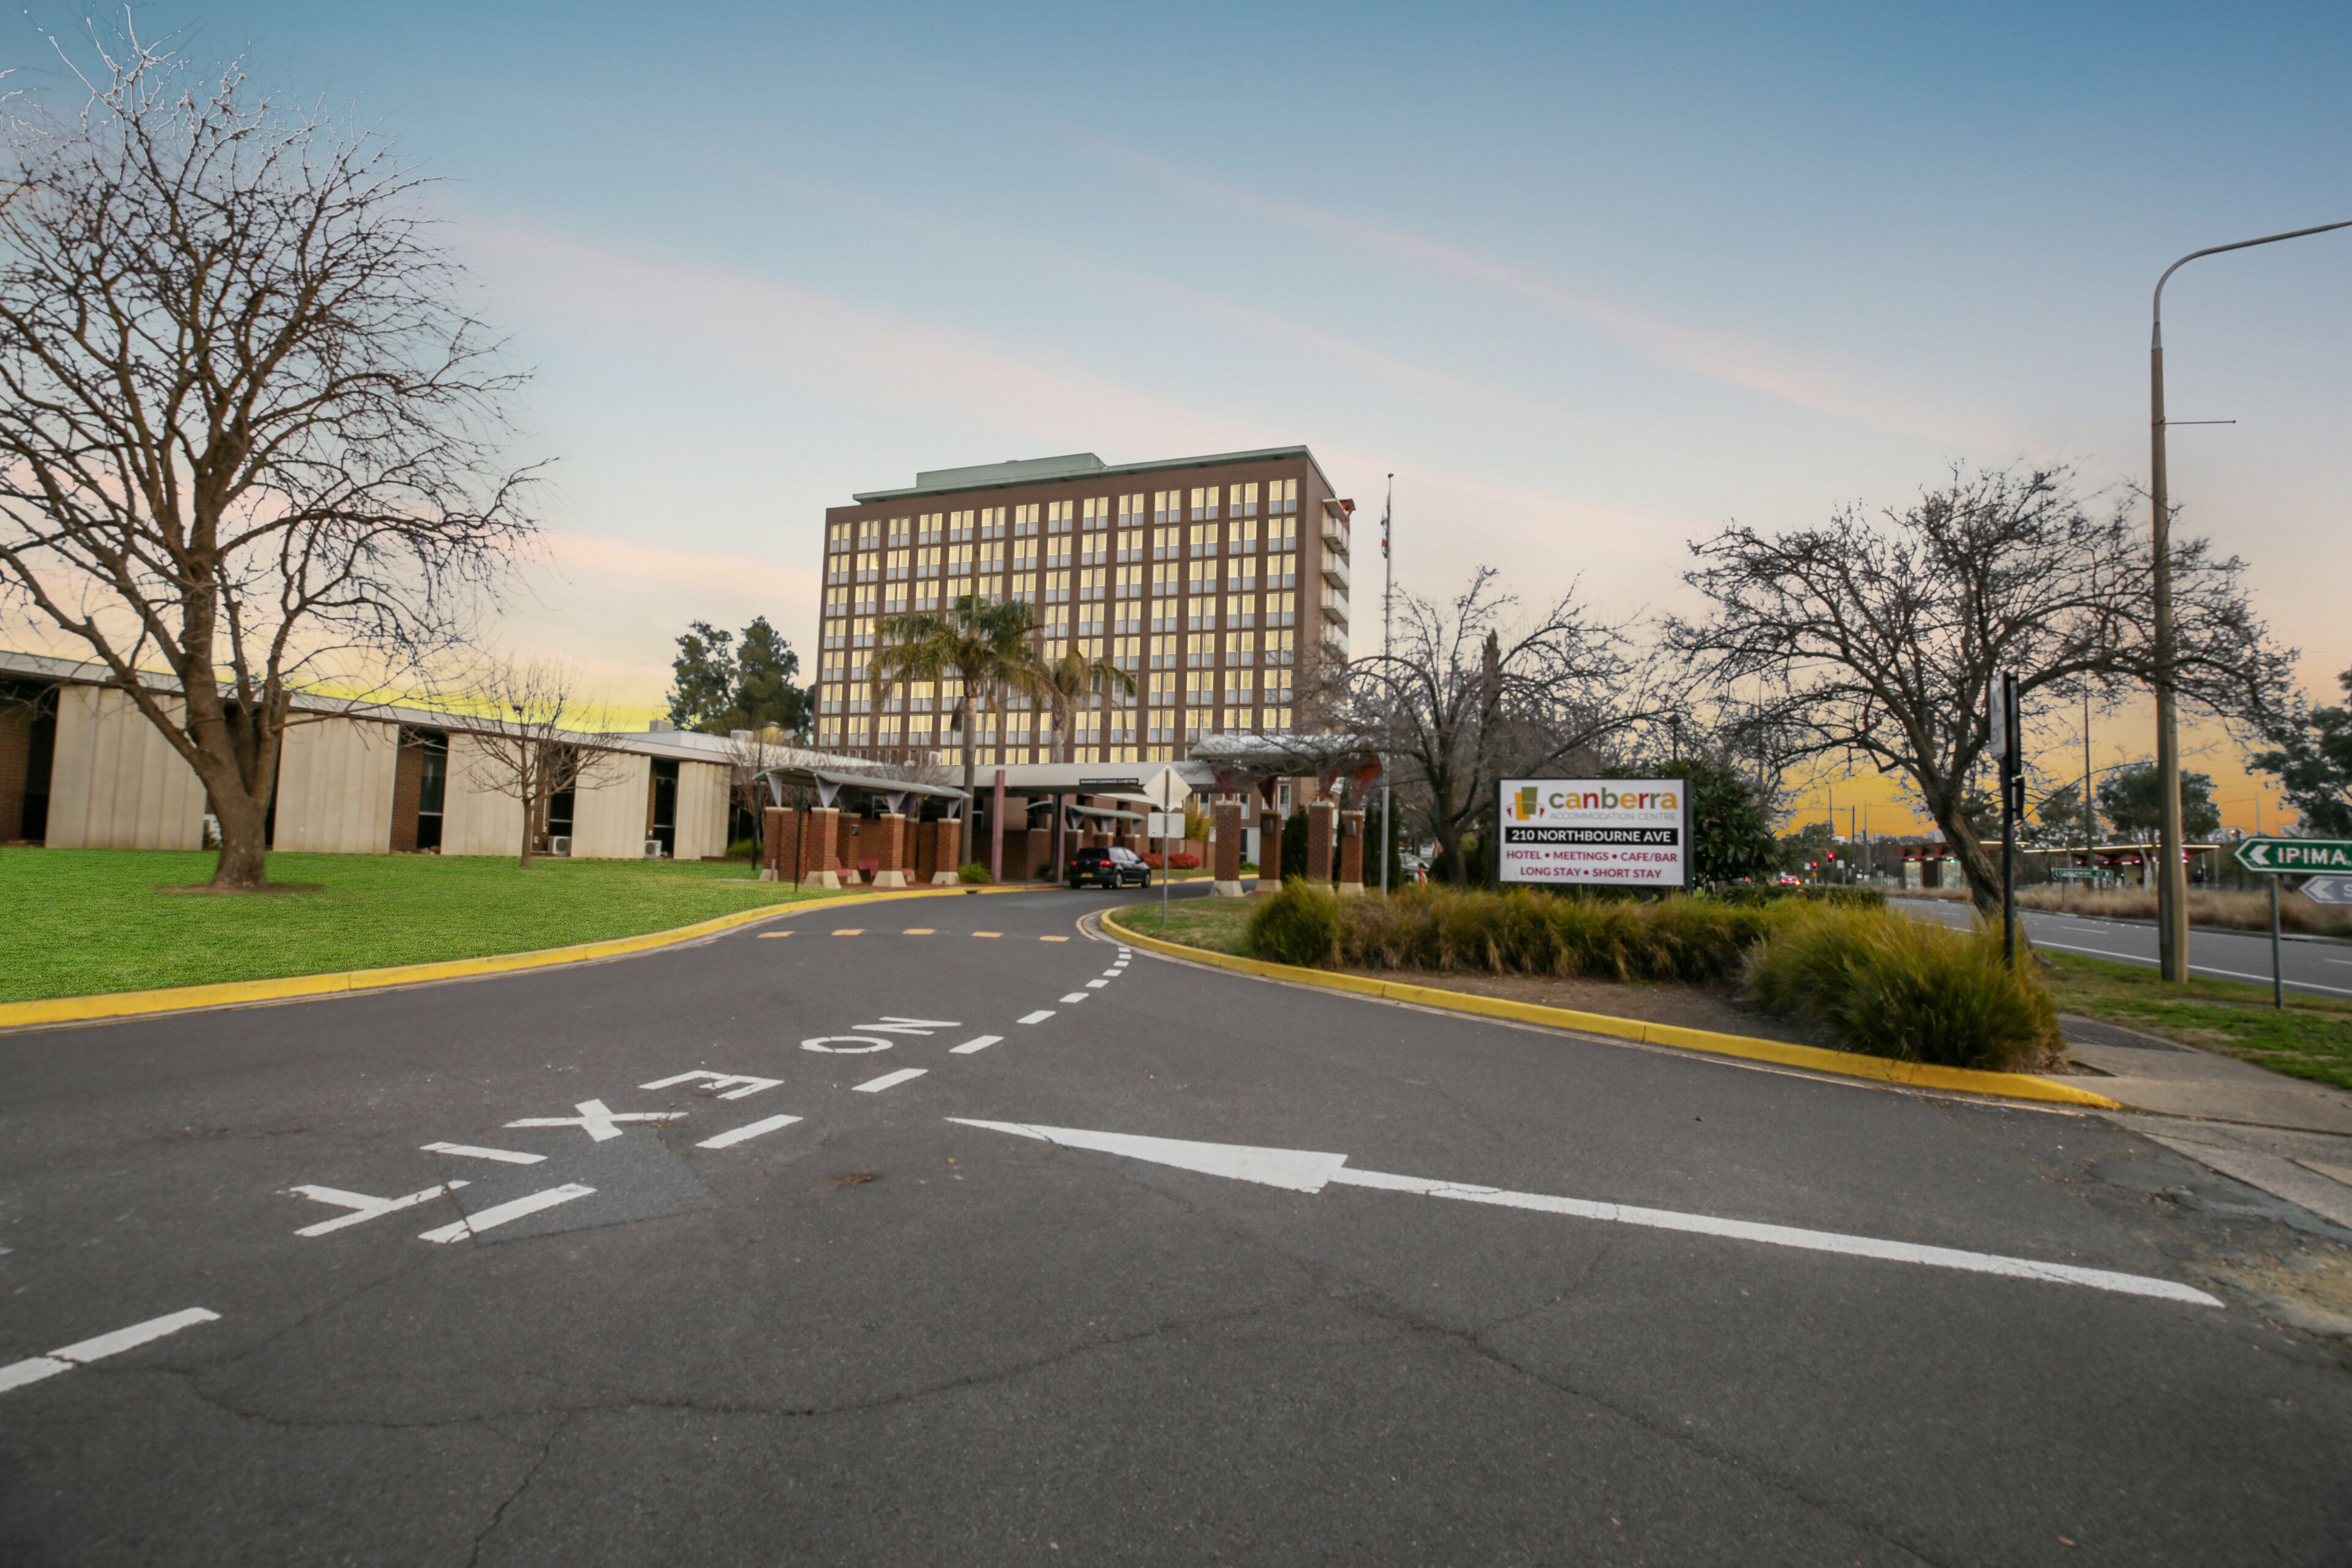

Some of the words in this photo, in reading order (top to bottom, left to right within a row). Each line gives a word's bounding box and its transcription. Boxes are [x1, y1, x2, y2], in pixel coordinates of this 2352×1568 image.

[1549, 787, 1678, 809] canberra
[1512, 829, 1534, 841] 210
[1538, 830, 1641, 842] NORTHBOURNE
[1643, 831, 1672, 843] AVE
[1507, 851, 1542, 860] HOTEL
[1553, 851, 1609, 861] MEETINGS
[1621, 852, 1678, 862] CAFE/BAR
[2277, 848, 2347, 865] IPIMA
[1520, 867, 1551, 876] LONG
[1554, 868, 1581, 876] STAY
[1593, 869, 1630, 878] SHORT
[1633, 869, 1662, 878] STAY
[799, 1016, 962, 1054] NO
